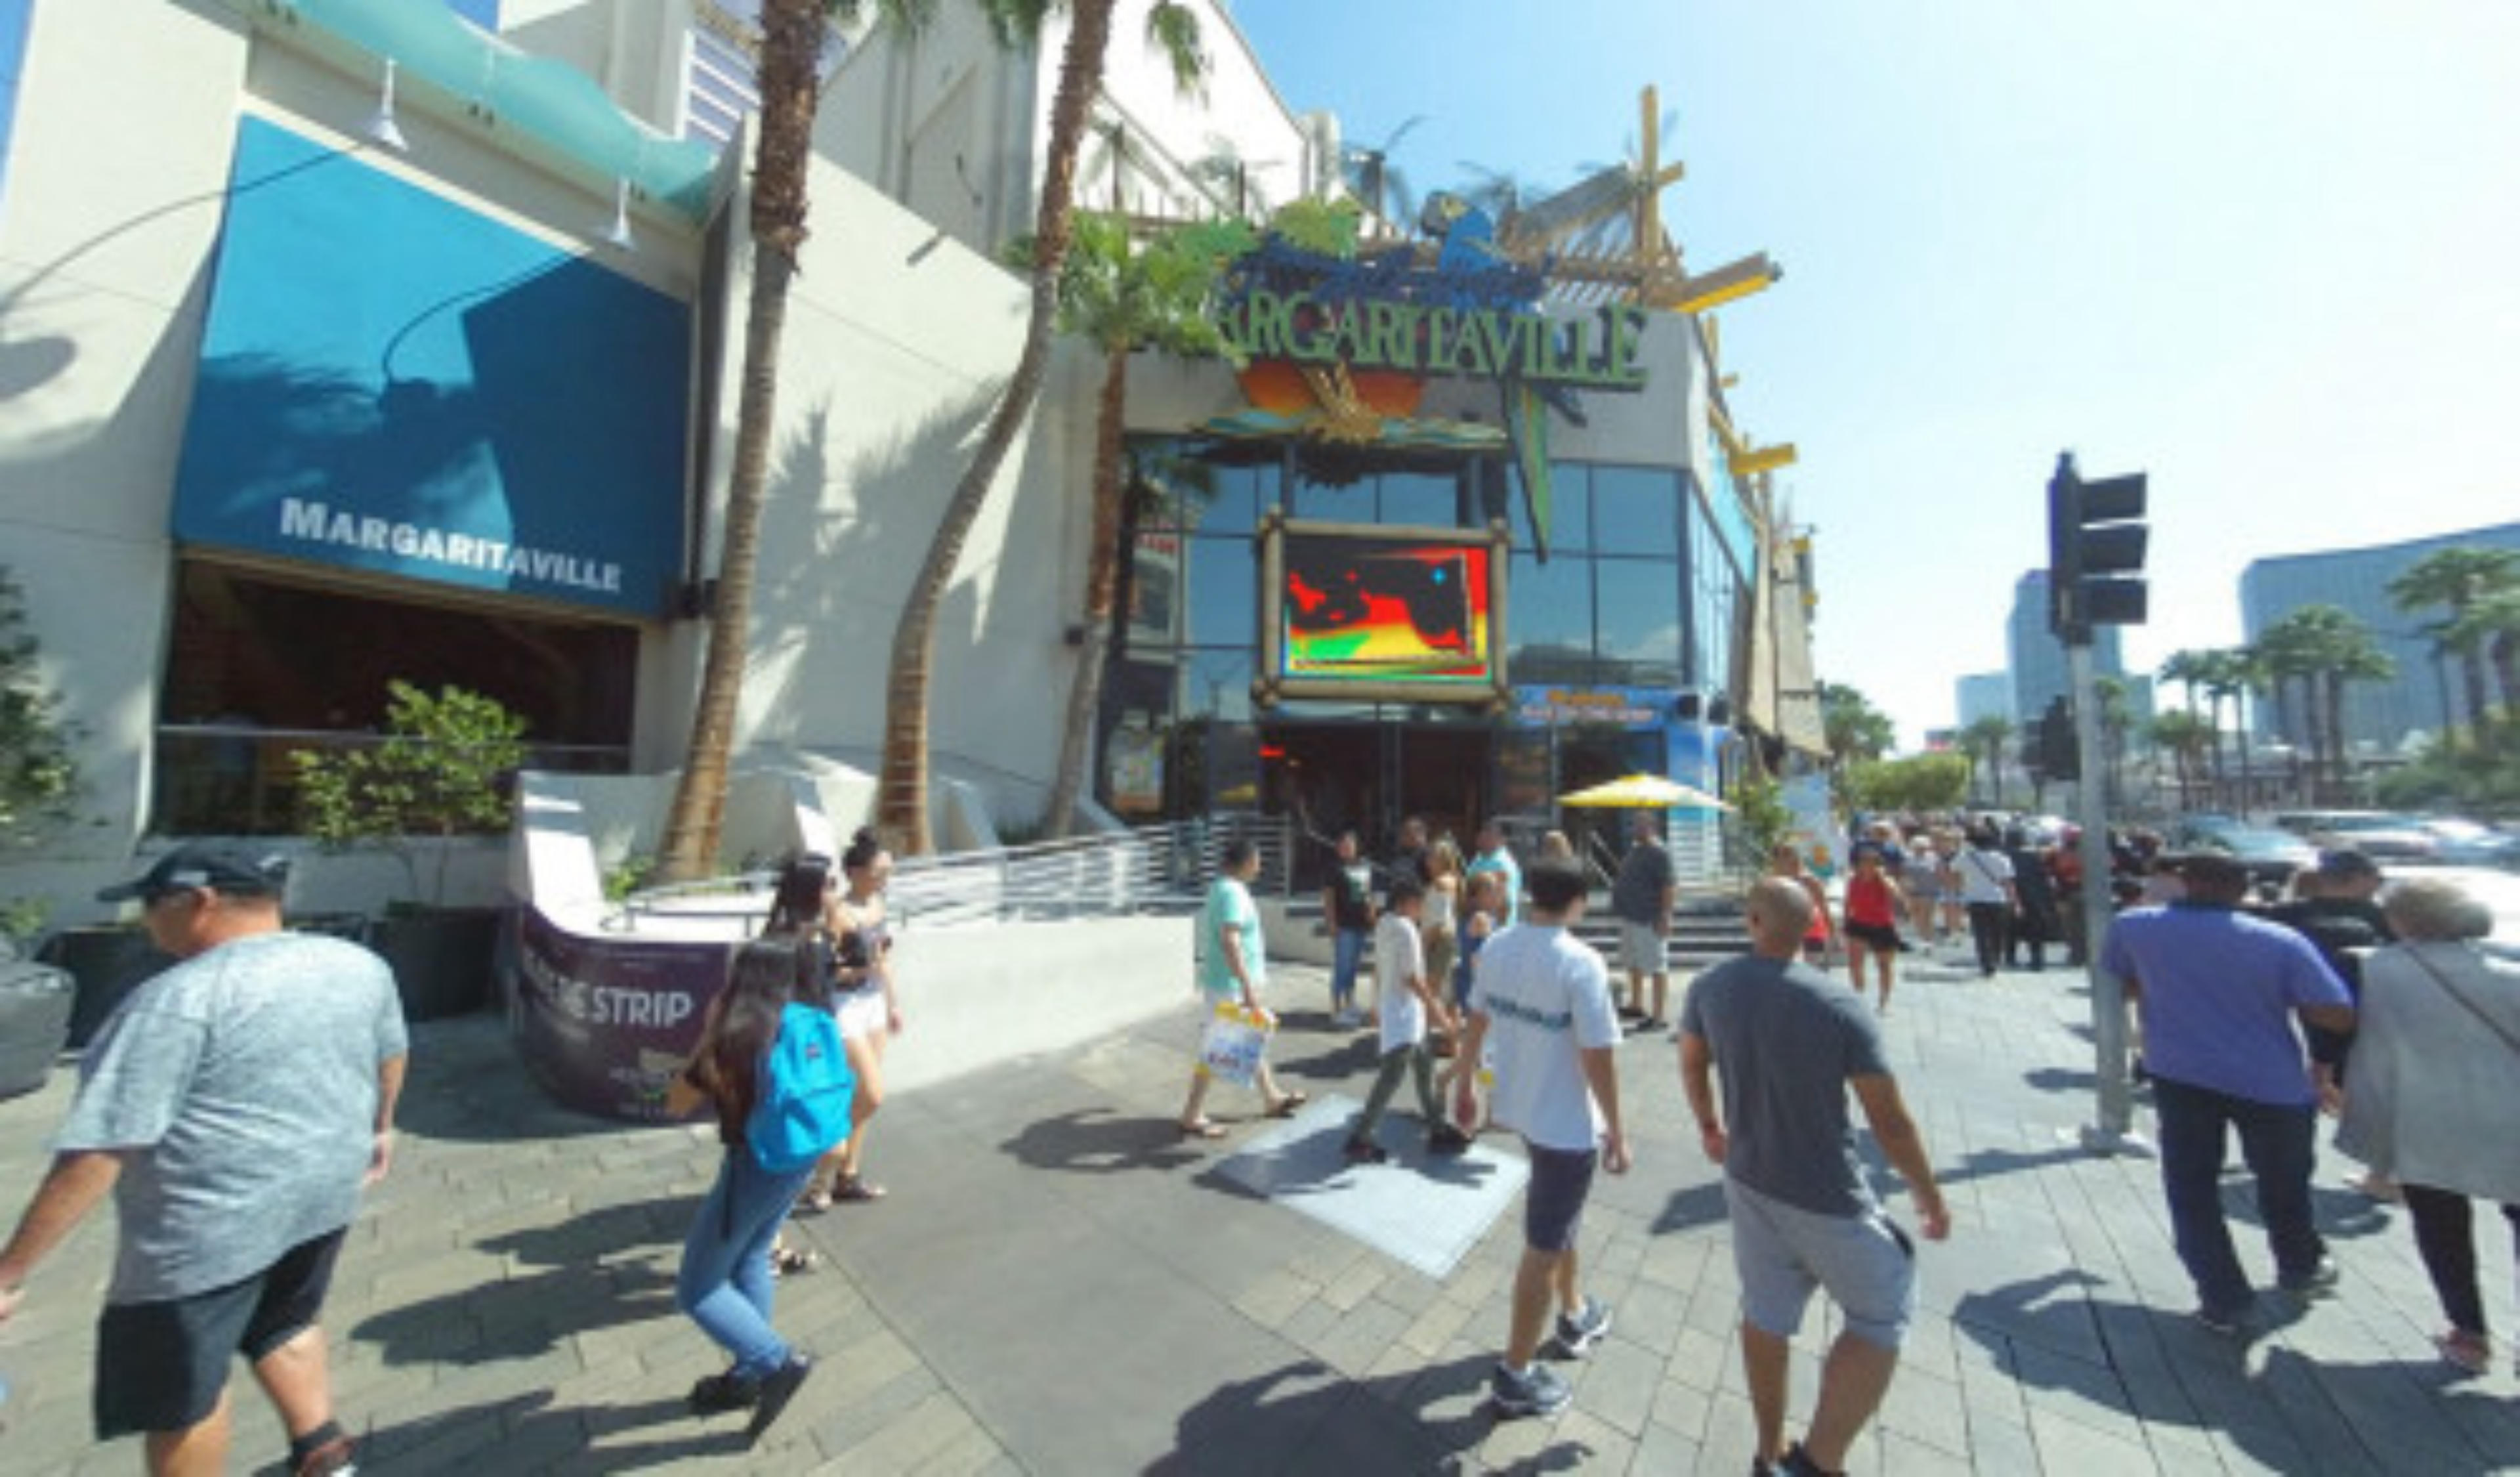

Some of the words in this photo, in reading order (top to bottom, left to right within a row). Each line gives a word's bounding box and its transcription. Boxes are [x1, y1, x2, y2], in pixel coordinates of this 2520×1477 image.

[1218, 290, 1648, 383] ARGARITAVILLE
[280, 496, 621, 591] MARGARITAVILLE
[592, 985, 693, 1027] STRIP
